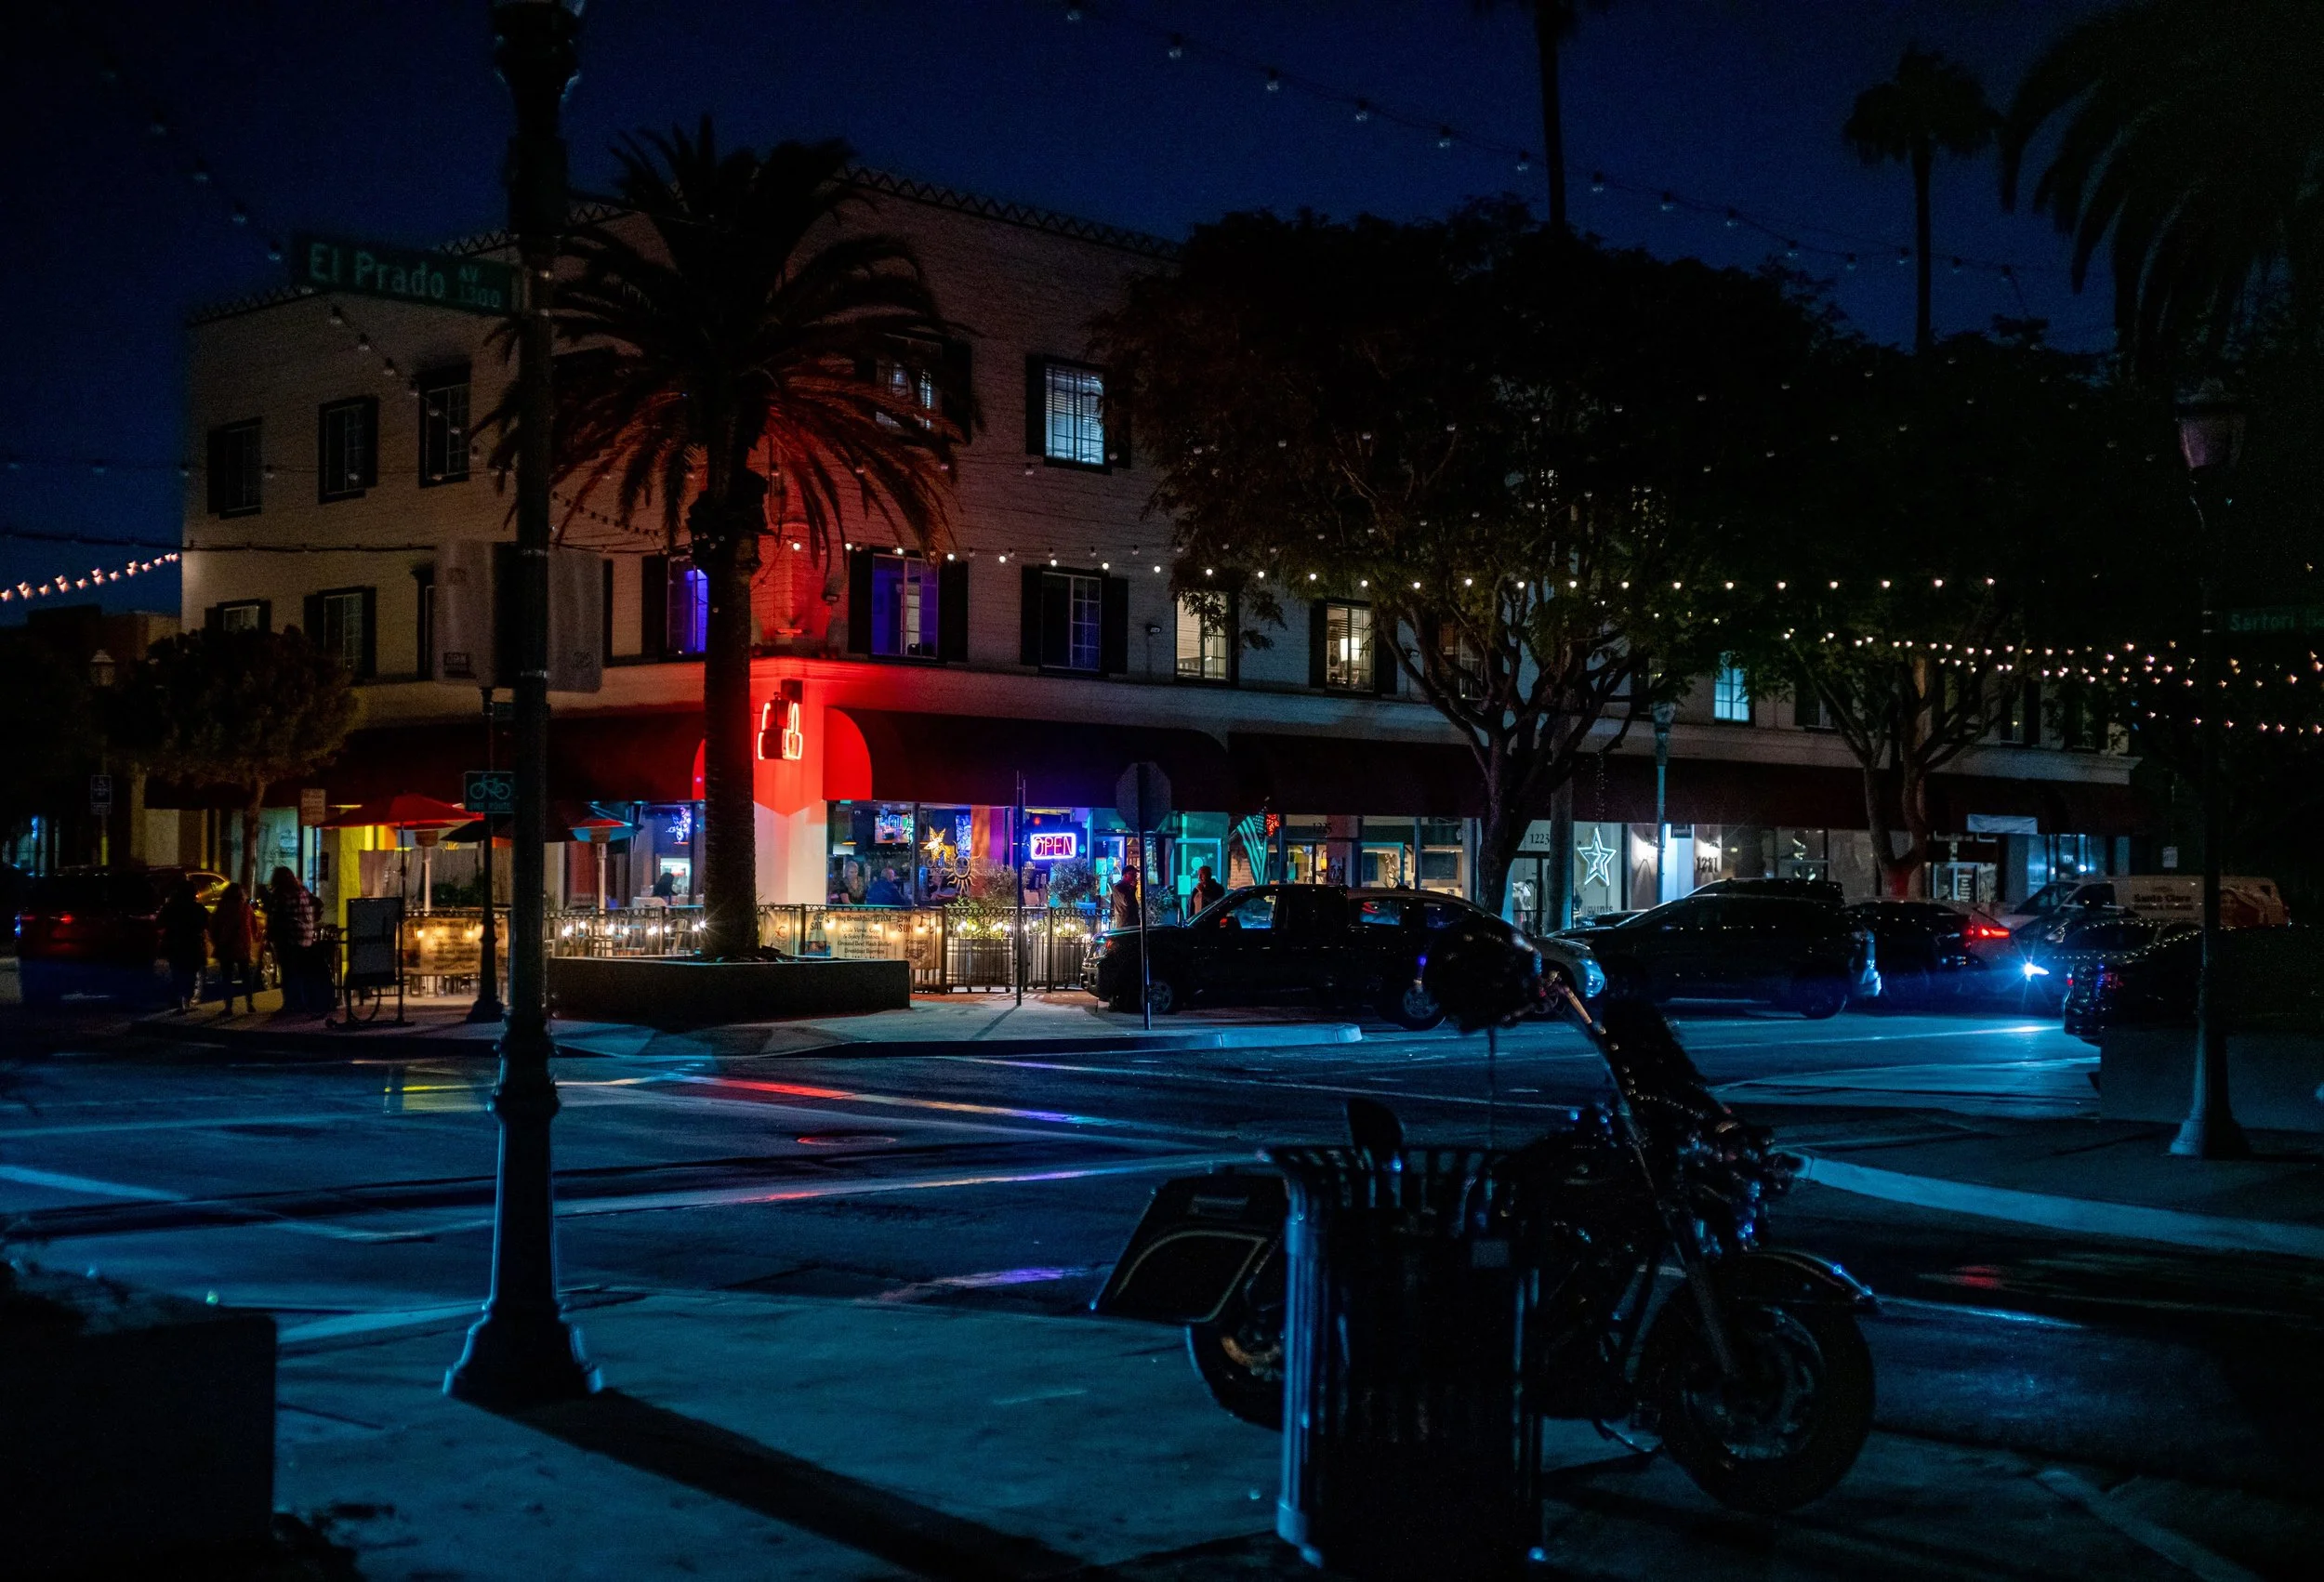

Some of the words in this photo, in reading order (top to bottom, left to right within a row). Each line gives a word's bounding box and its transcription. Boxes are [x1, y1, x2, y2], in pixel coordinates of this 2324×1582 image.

[309, 242, 340, 284] El
[355, 249, 446, 299] Prado
[1313, 822, 1332, 835] 1225
[1530, 833, 1551, 845] 1223
[1034, 837, 1073, 856] OPEN
[810, 921, 823, 930] SAT
[898, 923, 913, 933] SUN
